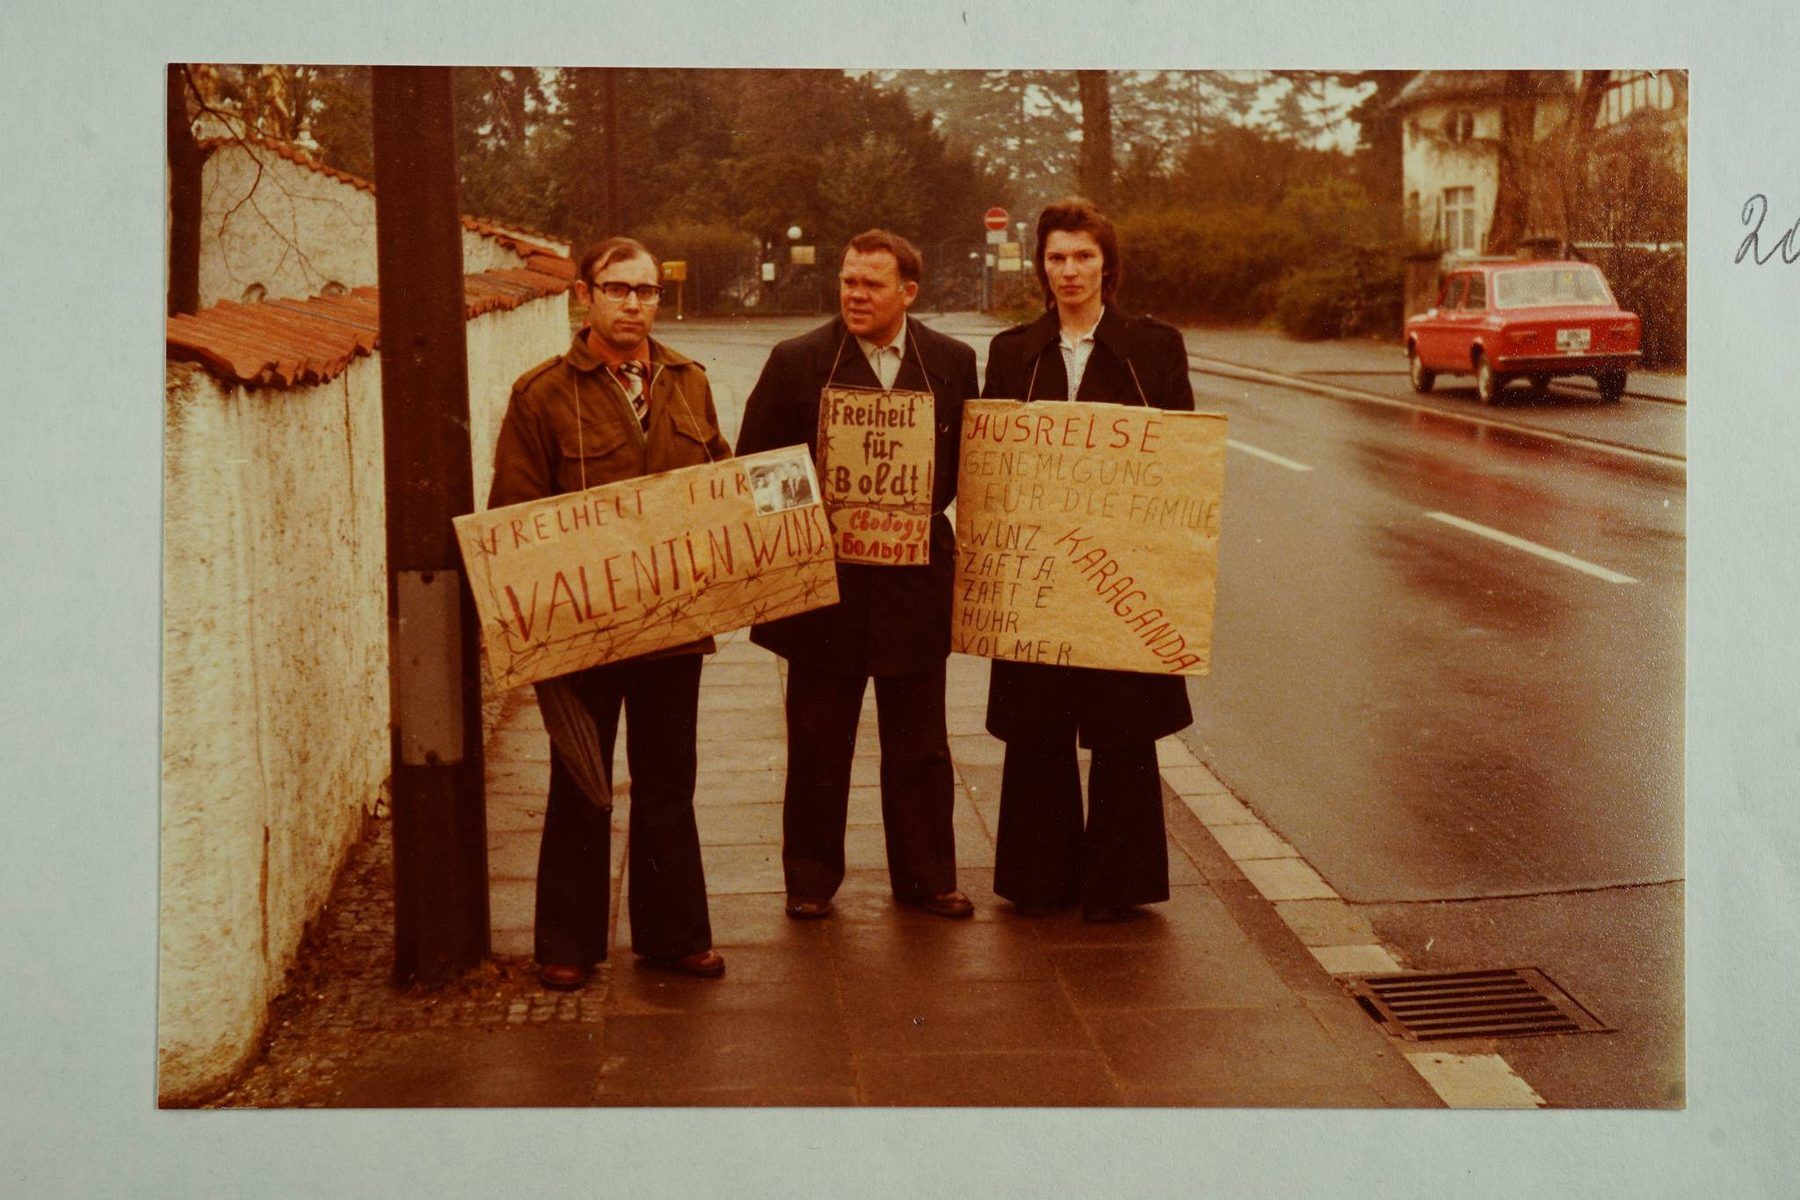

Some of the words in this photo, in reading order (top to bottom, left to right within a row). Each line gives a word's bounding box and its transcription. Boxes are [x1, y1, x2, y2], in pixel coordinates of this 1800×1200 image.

[863, 431, 903, 465] für
[983, 479, 1046, 513] FÜR
[1063, 486, 1120, 519] DIE
[1128, 493, 1222, 530] FAMILIE
[970, 519, 1042, 551] WINZ
[1053, 527, 1201, 673] KARAGANDA
[961, 606, 1021, 634] HUHR
